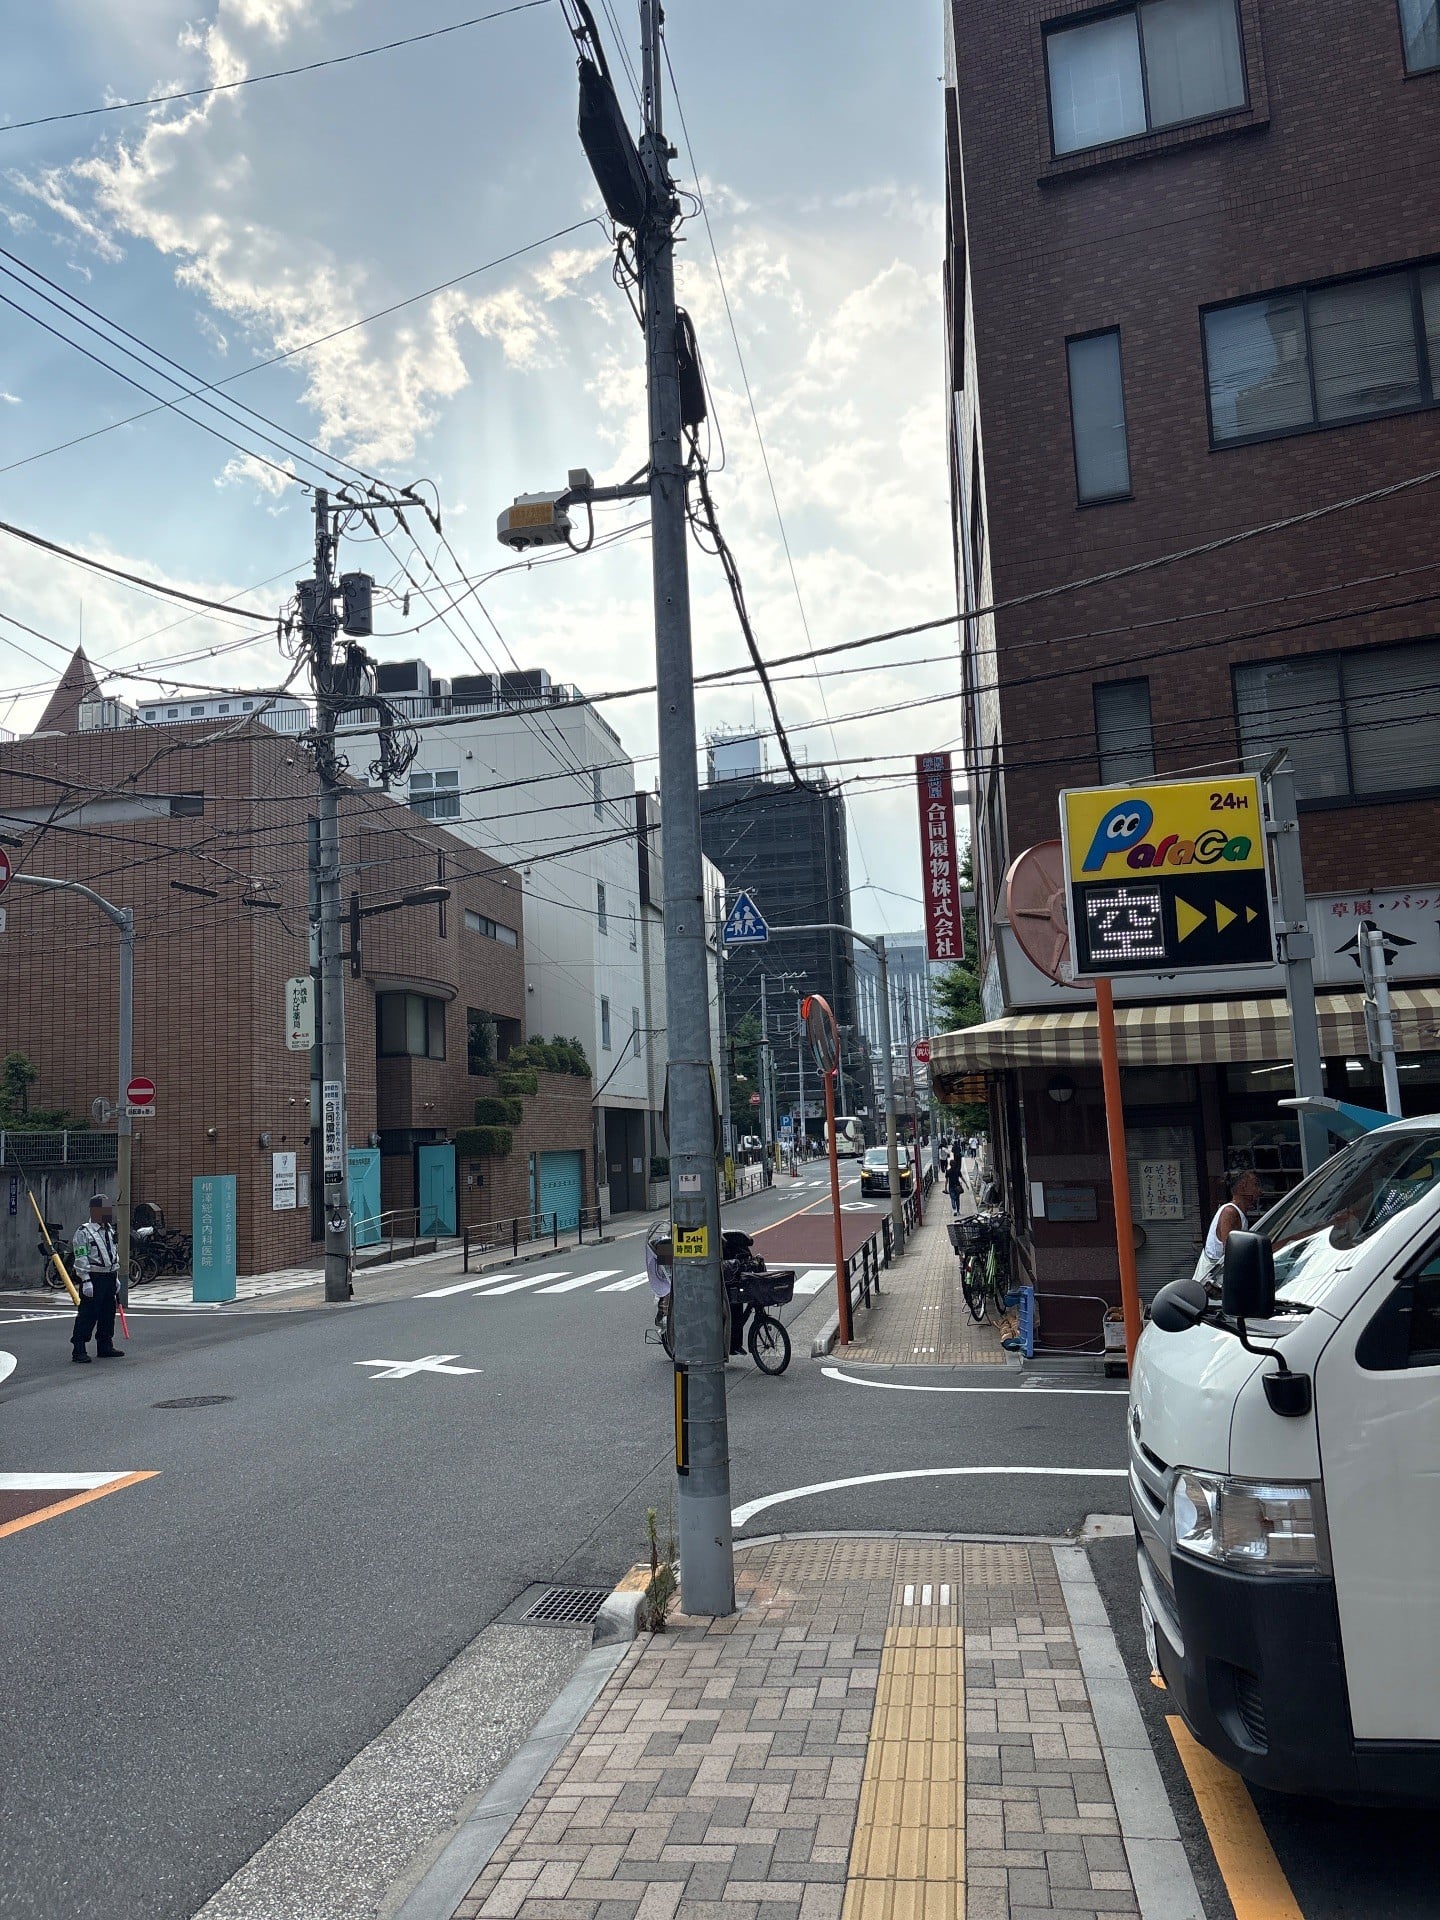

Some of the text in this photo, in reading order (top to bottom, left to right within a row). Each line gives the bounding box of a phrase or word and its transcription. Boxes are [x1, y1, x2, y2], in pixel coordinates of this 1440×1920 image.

[1209, 792, 1248, 811] 24H
[926, 802, 956, 957] 合同履物株式会社
[1087, 889, 1165, 960] 空
[783, 1116, 790, 1125] P
[201, 1182, 213, 1267] 柳澤総合内科医院
[685, 1235, 703, 1243] 24H
[676, 1244, 703, 1254] 時間貸
